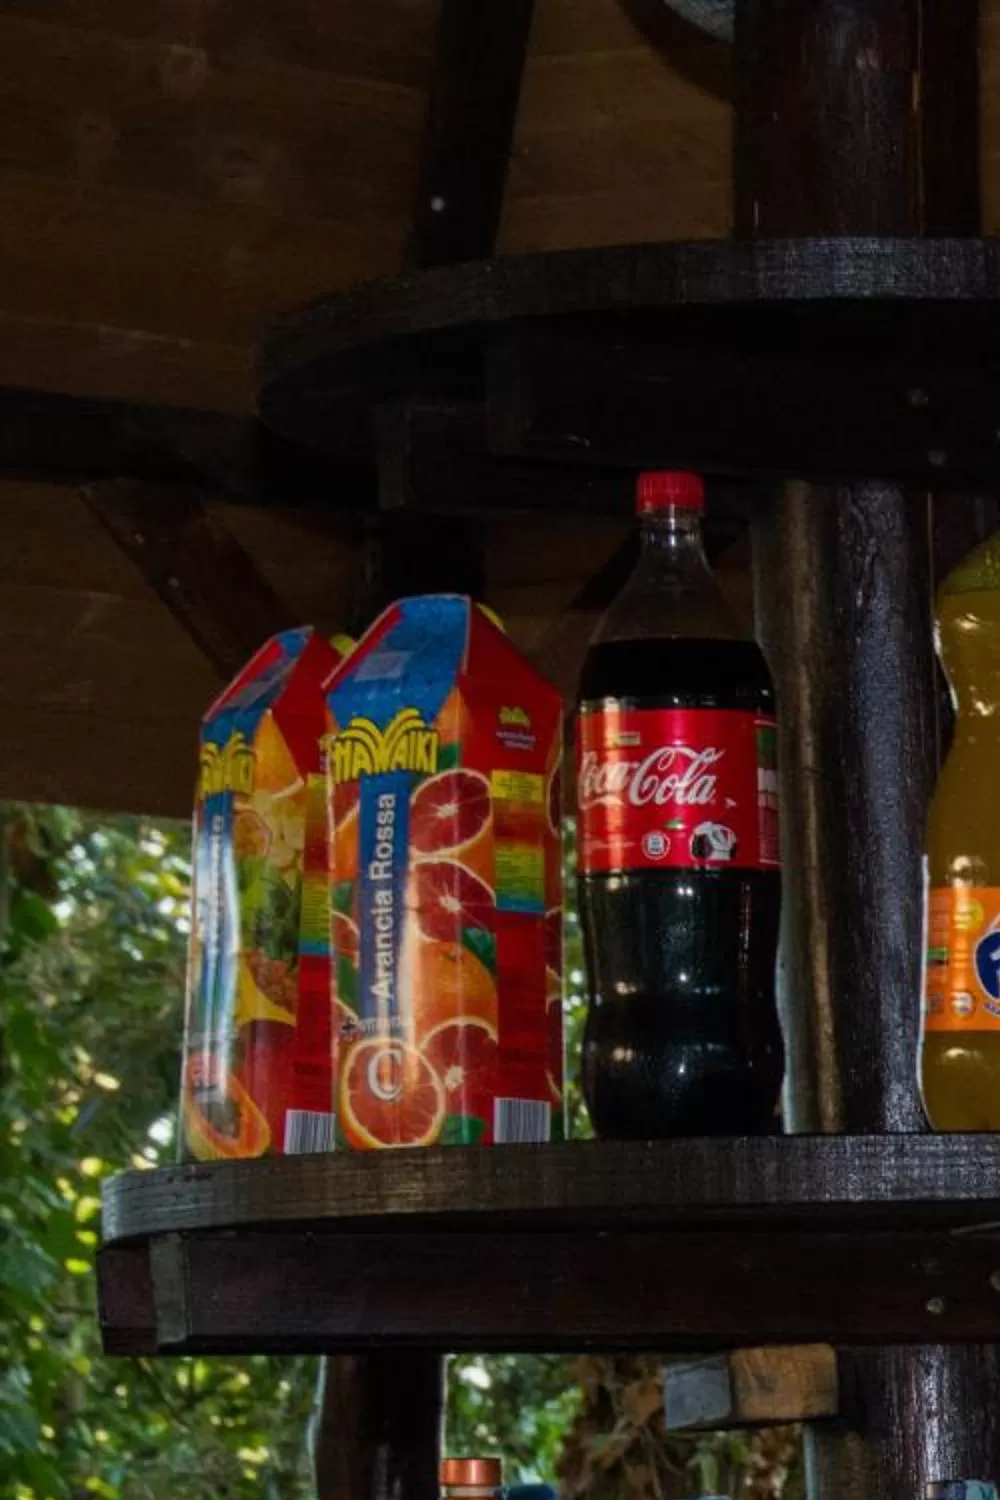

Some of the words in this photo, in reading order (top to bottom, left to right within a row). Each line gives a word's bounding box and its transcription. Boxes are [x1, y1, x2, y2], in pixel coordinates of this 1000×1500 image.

[579, 745, 726, 810] Coca-Cola
[368, 792, 397, 881] Rossa
[369, 889, 395, 998] Arancia
